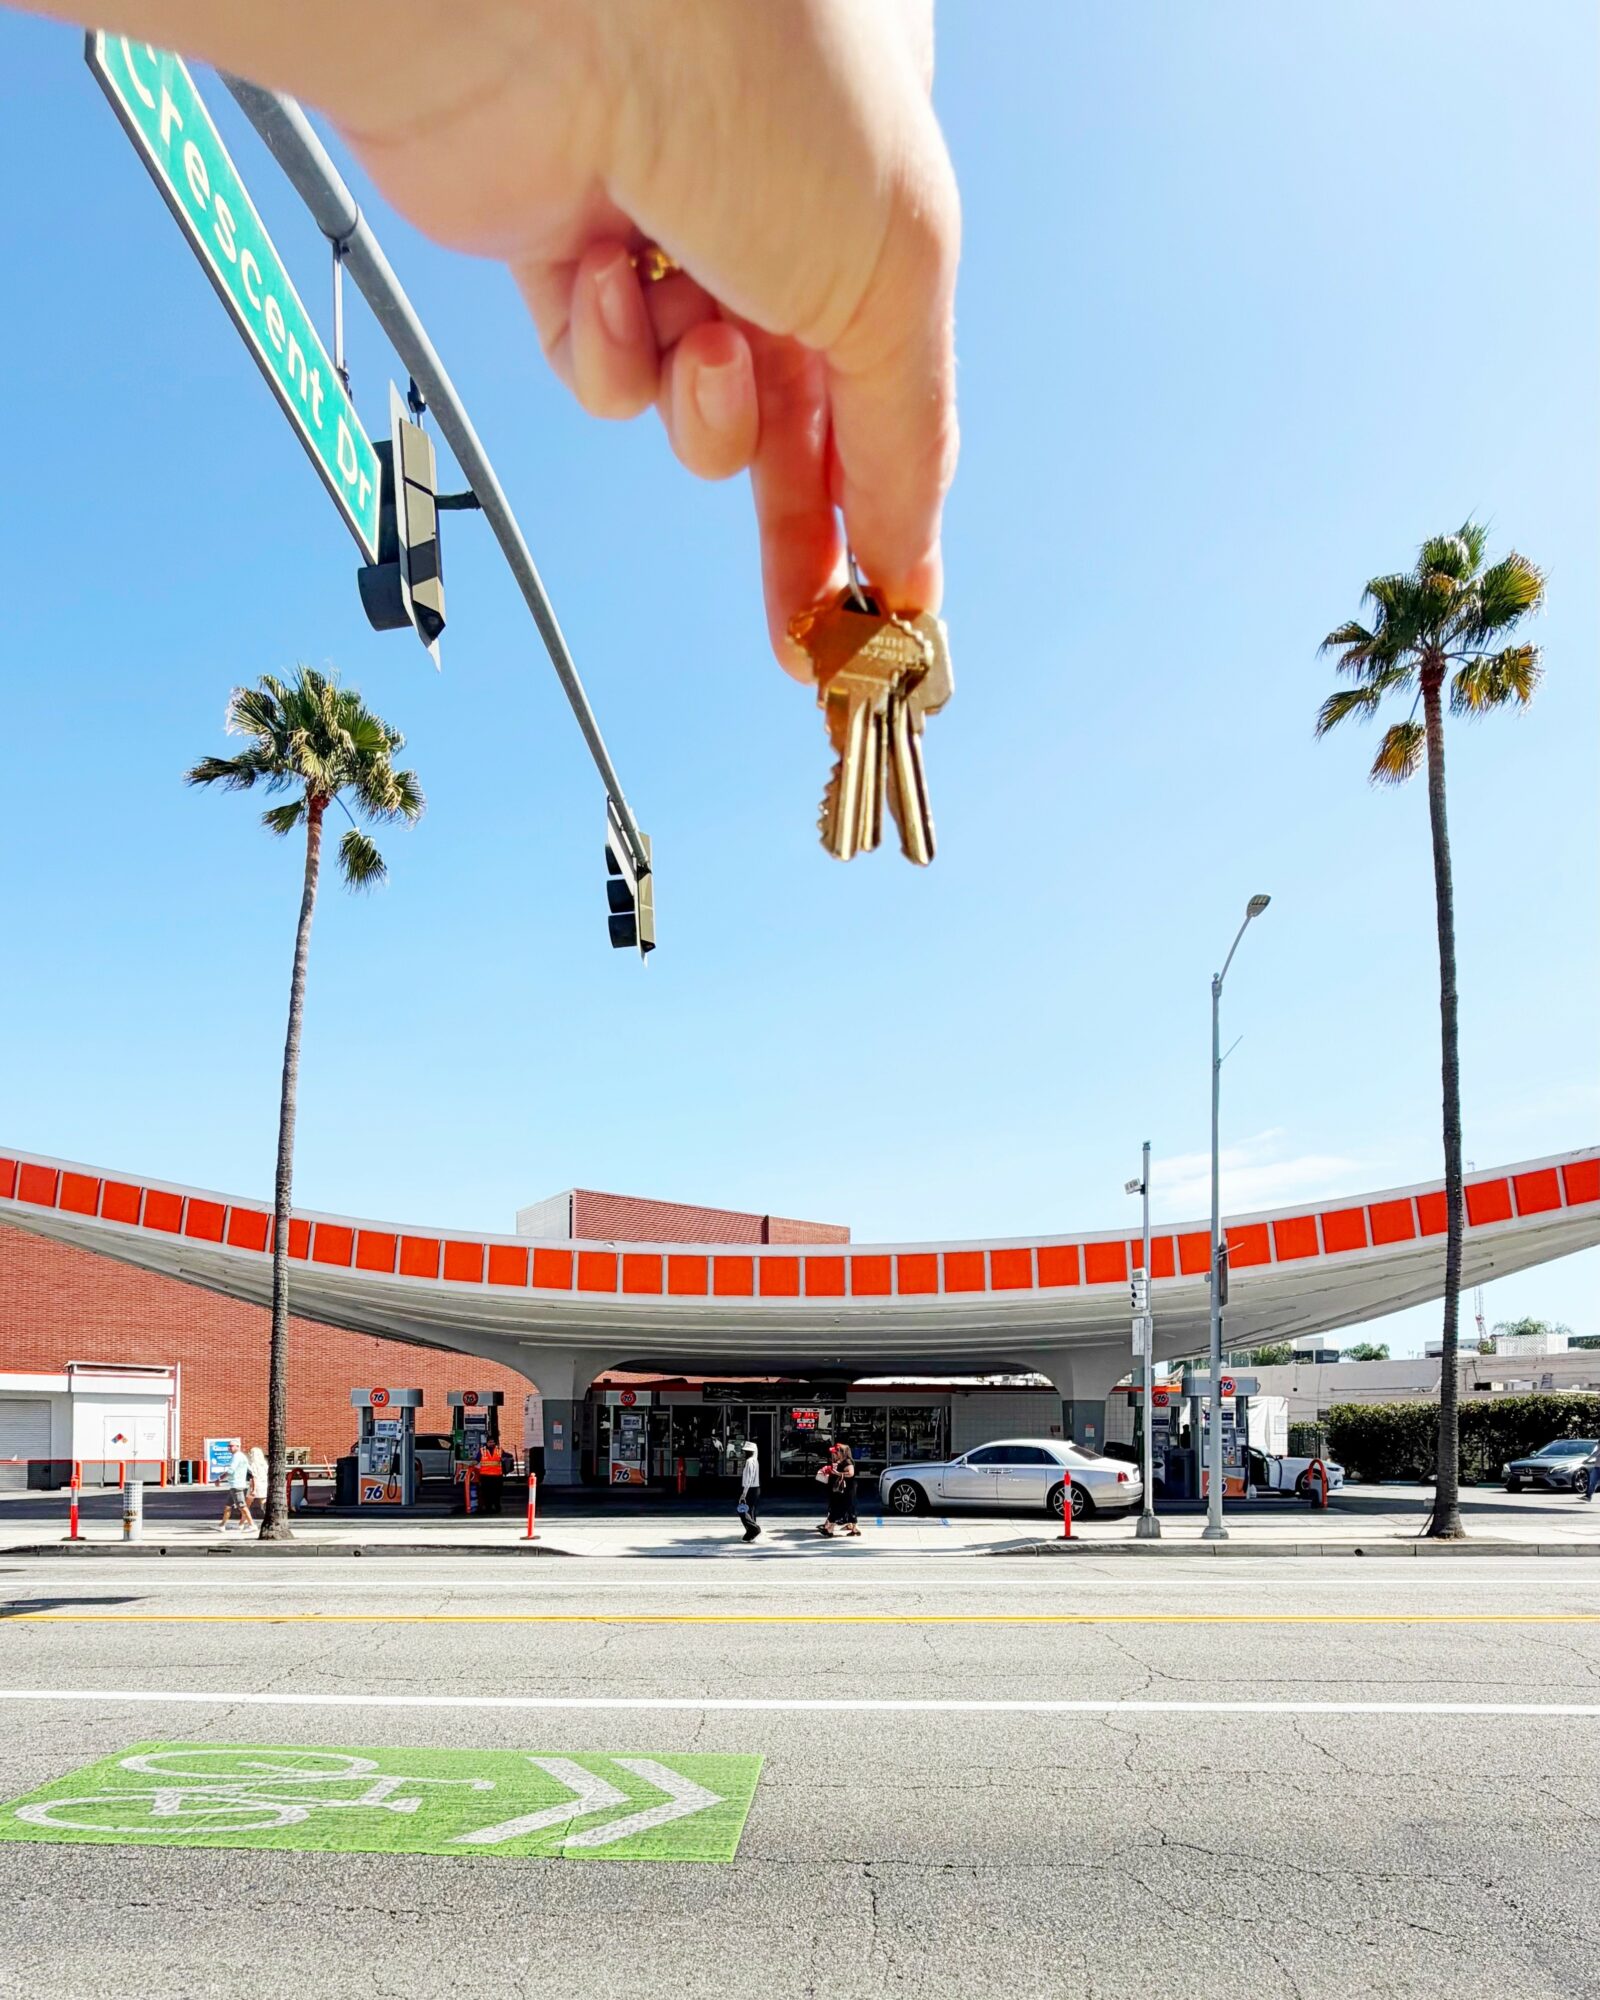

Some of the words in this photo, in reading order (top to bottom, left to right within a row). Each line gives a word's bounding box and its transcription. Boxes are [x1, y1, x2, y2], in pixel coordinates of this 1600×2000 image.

[336, 413, 372, 511] Dr
[372, 1392, 385, 1403] 76
[615, 1469, 631, 1482] 76
[364, 1484, 384, 1501] 76
